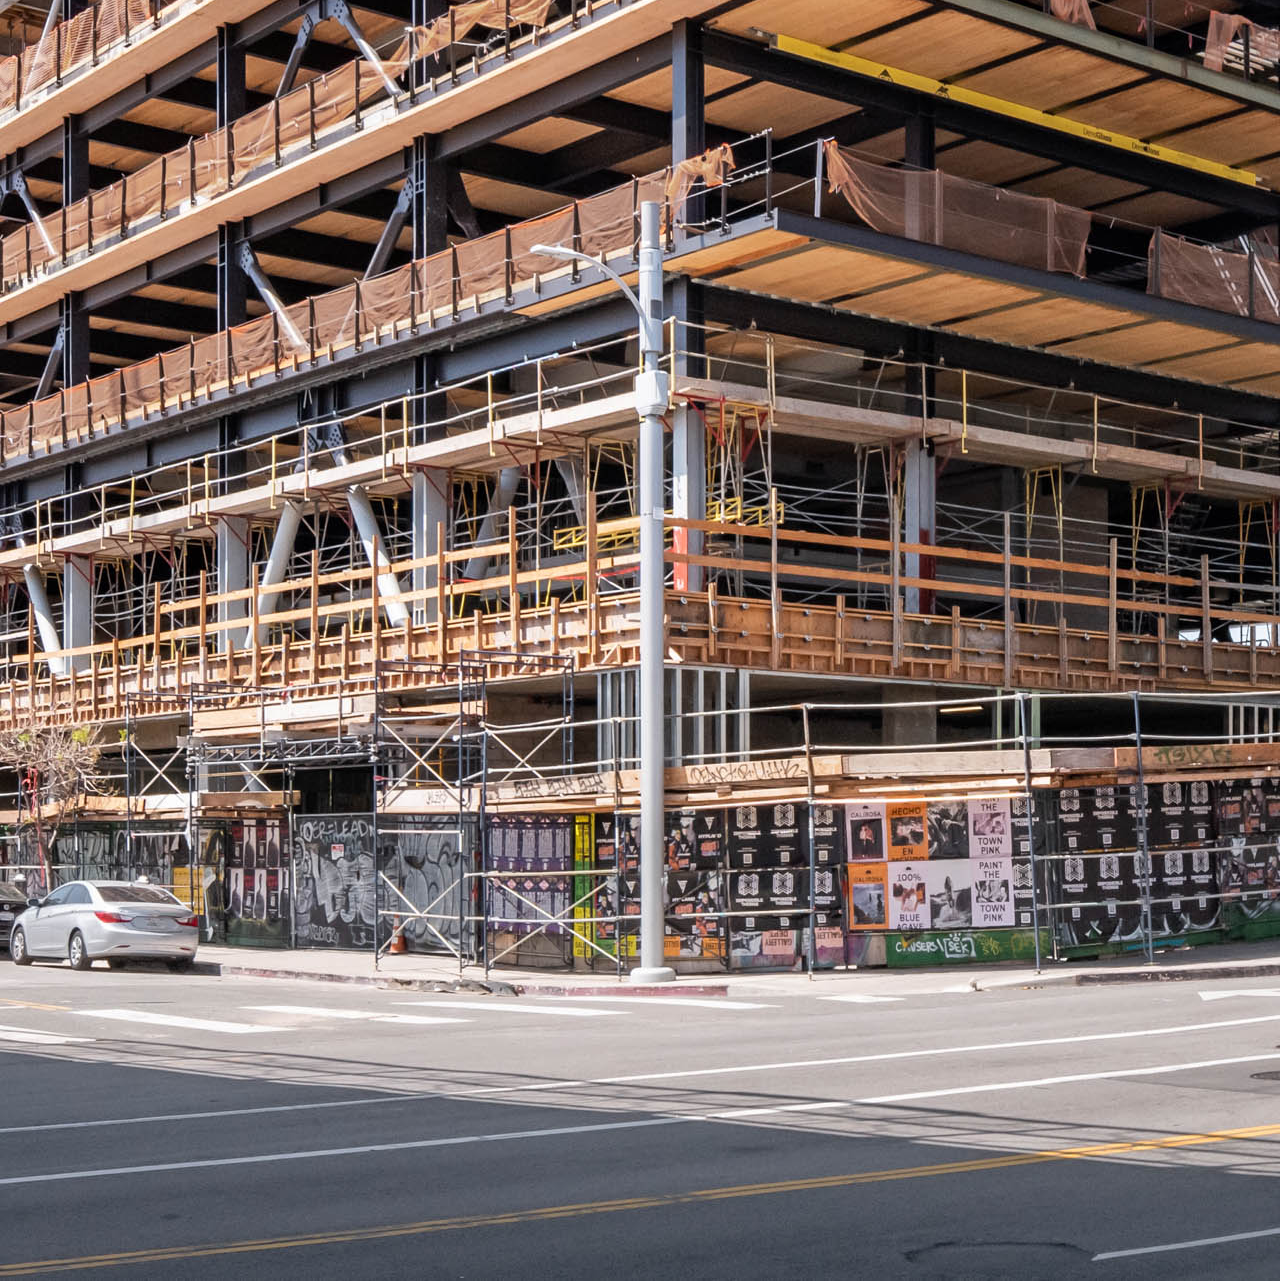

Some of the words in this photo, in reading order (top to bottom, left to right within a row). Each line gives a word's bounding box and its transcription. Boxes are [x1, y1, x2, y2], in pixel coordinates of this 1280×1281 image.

[892, 807, 921, 815] HECHO
[981, 804, 998, 812] THE
[850, 810, 882, 818] CALIROSA
[981, 847, 1000, 855] PINK
[897, 874, 922, 882] 100%
[984, 871, 1000, 879] THE
[981, 904, 1006, 912] TOWN
[899, 914, 920, 922] BLUE
[984, 914, 1003, 922] PINK
[765, 938, 792, 946] GALLERY
